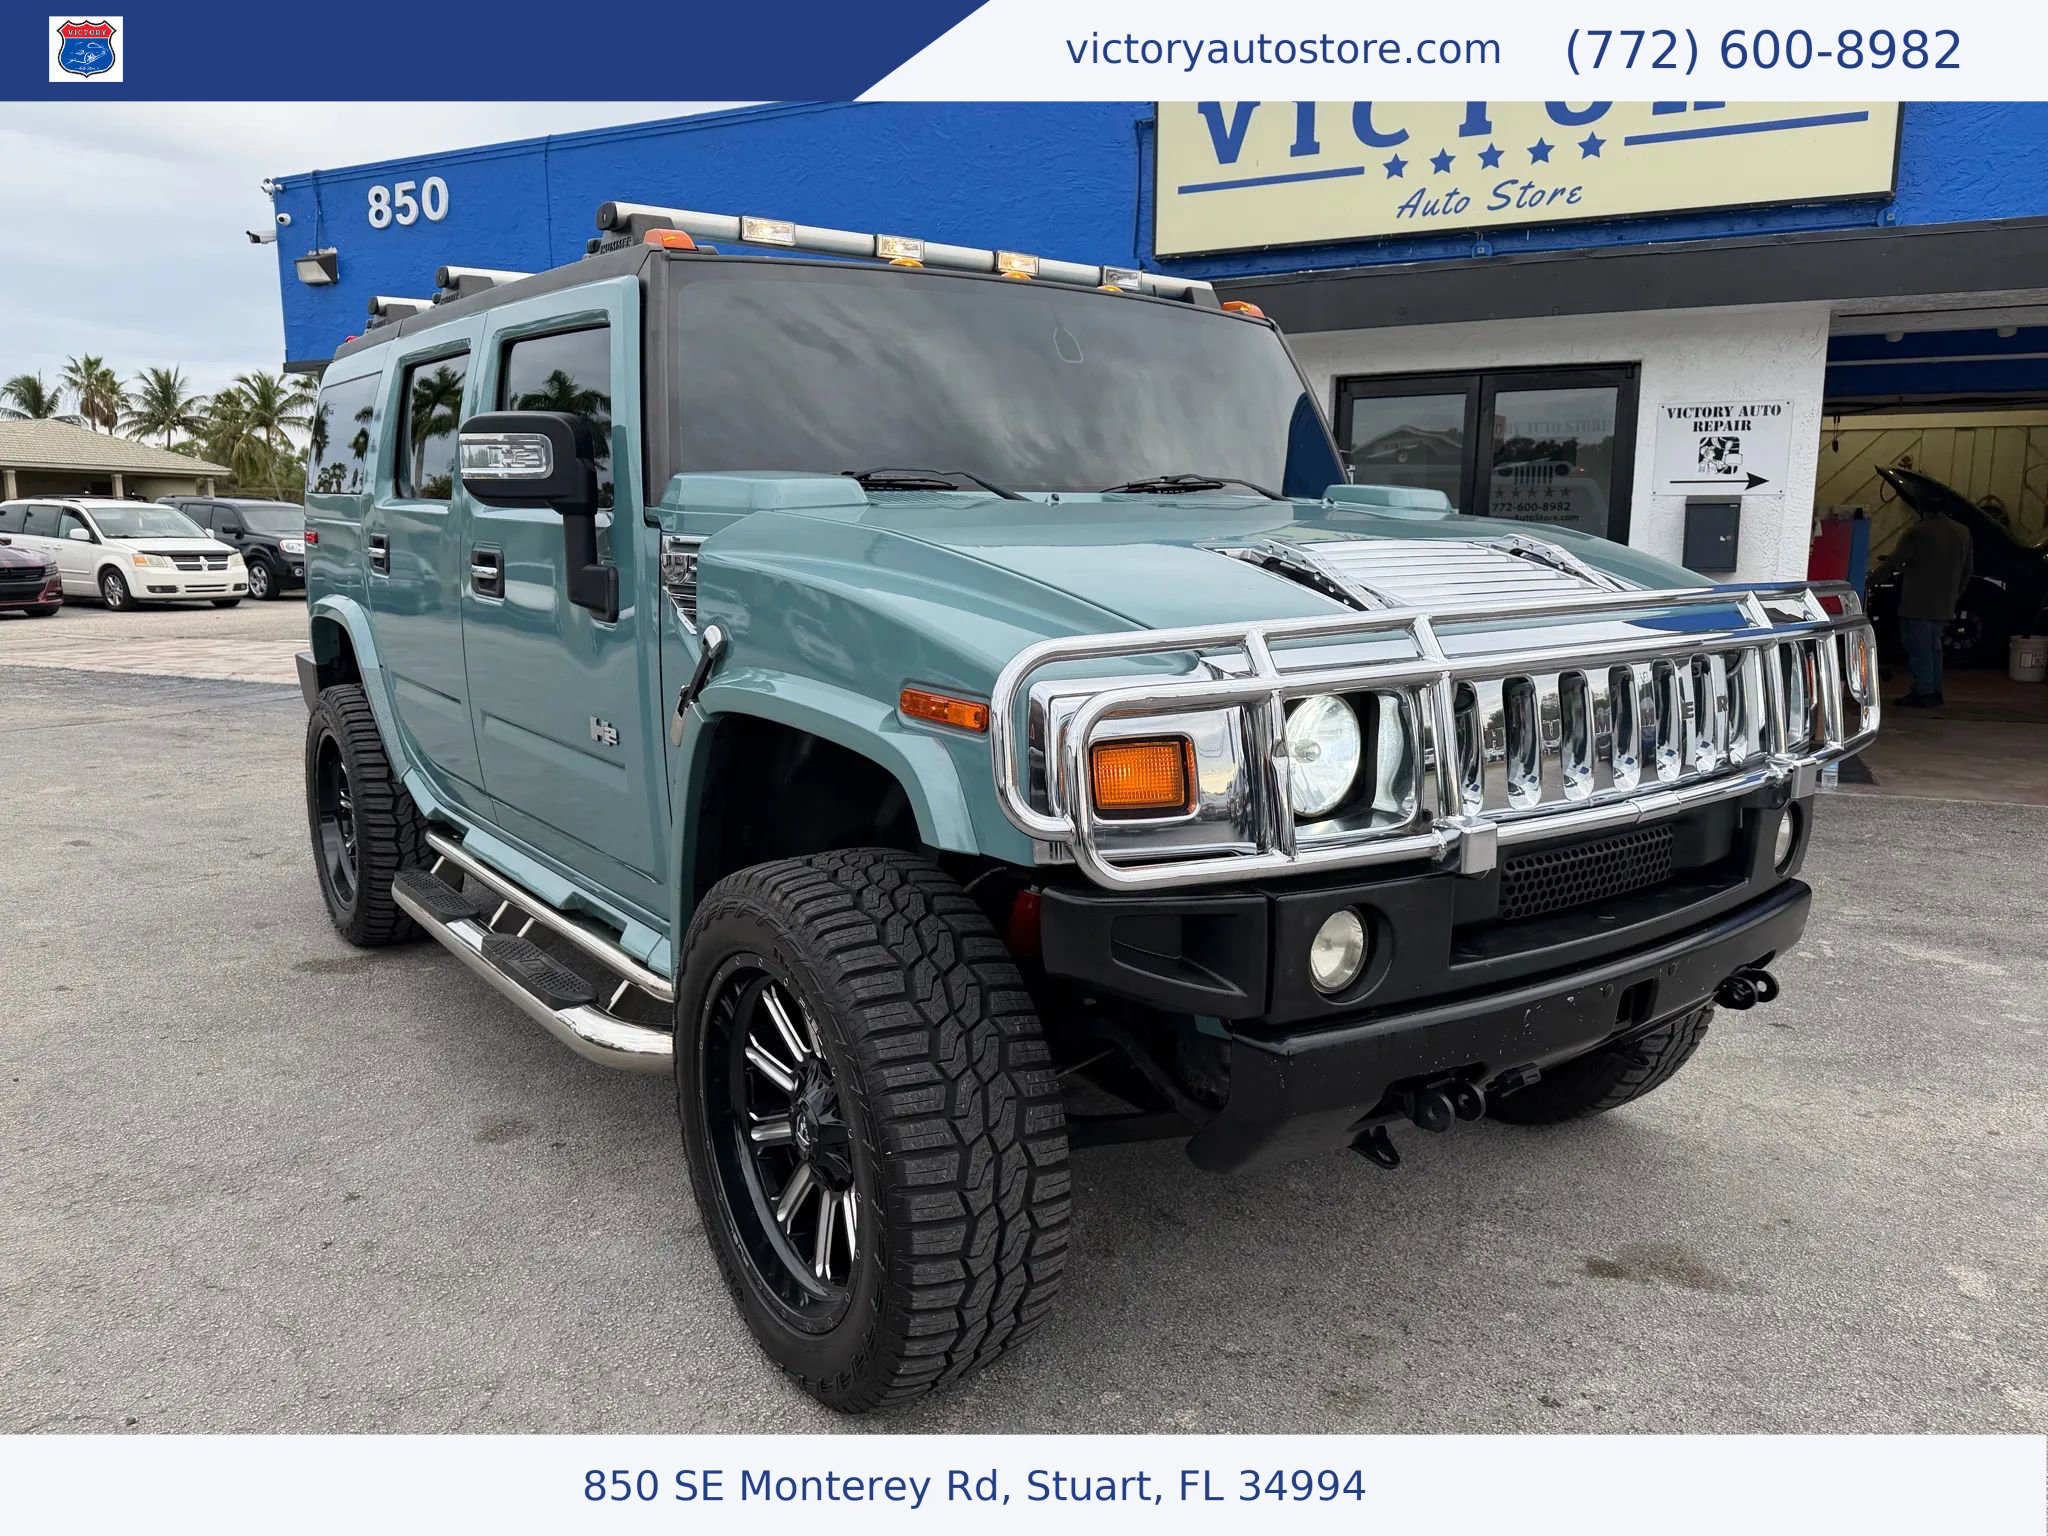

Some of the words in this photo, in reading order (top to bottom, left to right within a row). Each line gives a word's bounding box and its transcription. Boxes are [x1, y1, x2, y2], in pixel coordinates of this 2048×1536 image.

[367, 176, 449, 229] 850
[1396, 187, 1471, 219] Auto
[1487, 179, 1583, 211] Store
[1667, 405, 1734, 419] VICTORY
[1739, 404, 1782, 417] AUTO
[1693, 419, 1752, 432] REPAIR
[1492, 502, 1571, 512] 772-600-8982
[590, 715, 618, 747] H2
